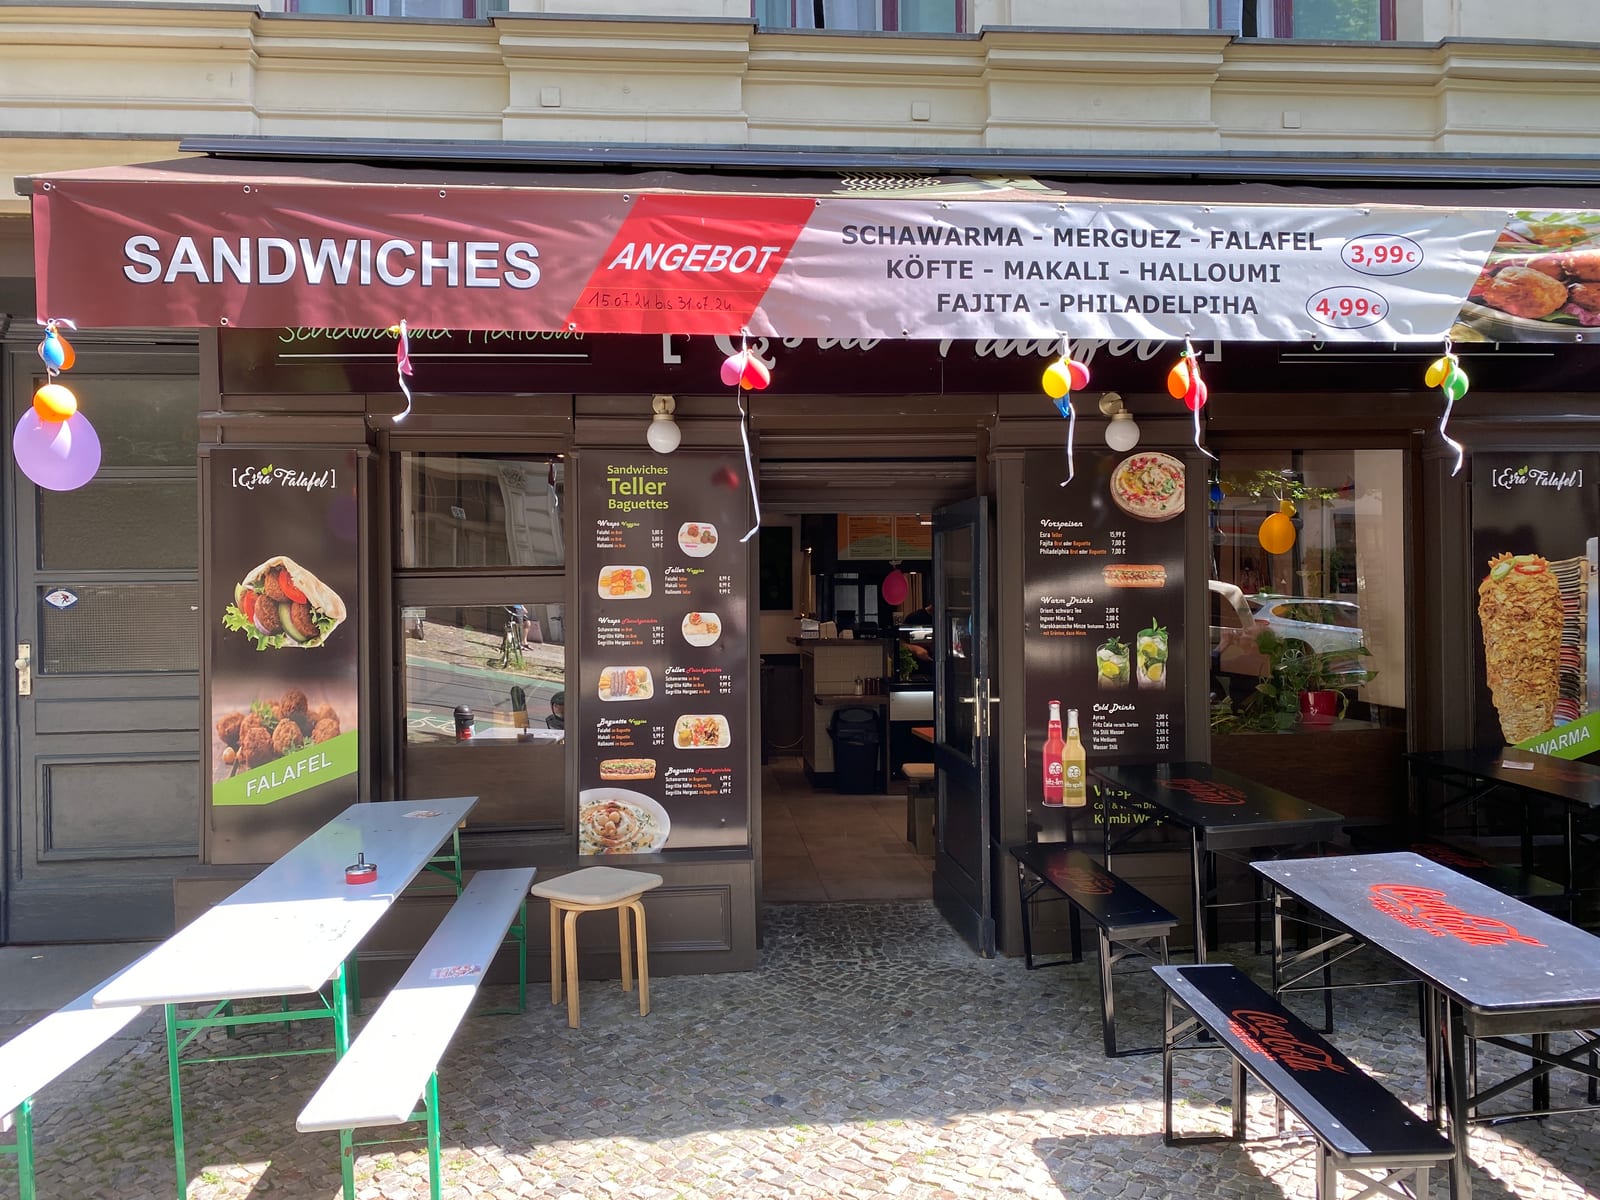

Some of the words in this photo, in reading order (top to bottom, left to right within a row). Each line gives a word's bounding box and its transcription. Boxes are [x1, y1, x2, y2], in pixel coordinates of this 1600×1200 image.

[842, 226, 1024, 246] SCHAWARMA
[1054, 228, 1182, 248] MERGUEZ
[1210, 230, 1322, 252] FALAFEL
[122, 235, 541, 289] SANDWICHES
[608, 242, 781, 273] ANGEBOT
[886, 255, 974, 280] KÖFTE
[1004, 260, 1110, 280] MAKALI
[1140, 262, 1281, 284] HALLOUMI
[655, 294, 673, 310] bis
[938, 294, 1031, 312] FAJITA
[1060, 294, 1259, 315] PHILADELPIHA
[607, 465, 668, 474] Sandwiches
[607, 476, 666, 495] Teller
[608, 499, 668, 512] Baguettes
[1040, 520, 1083, 530] Vorspeisen
[1066, 596, 1094, 606] Drinks
[1092, 704, 1108, 712] Cold
[1108, 704, 1136, 714] Drinks
[1529, 726, 1590, 755] WARMA
[247, 752, 332, 797] FALAFEL
[1369, 884, 1549, 947] Coca-Cola
